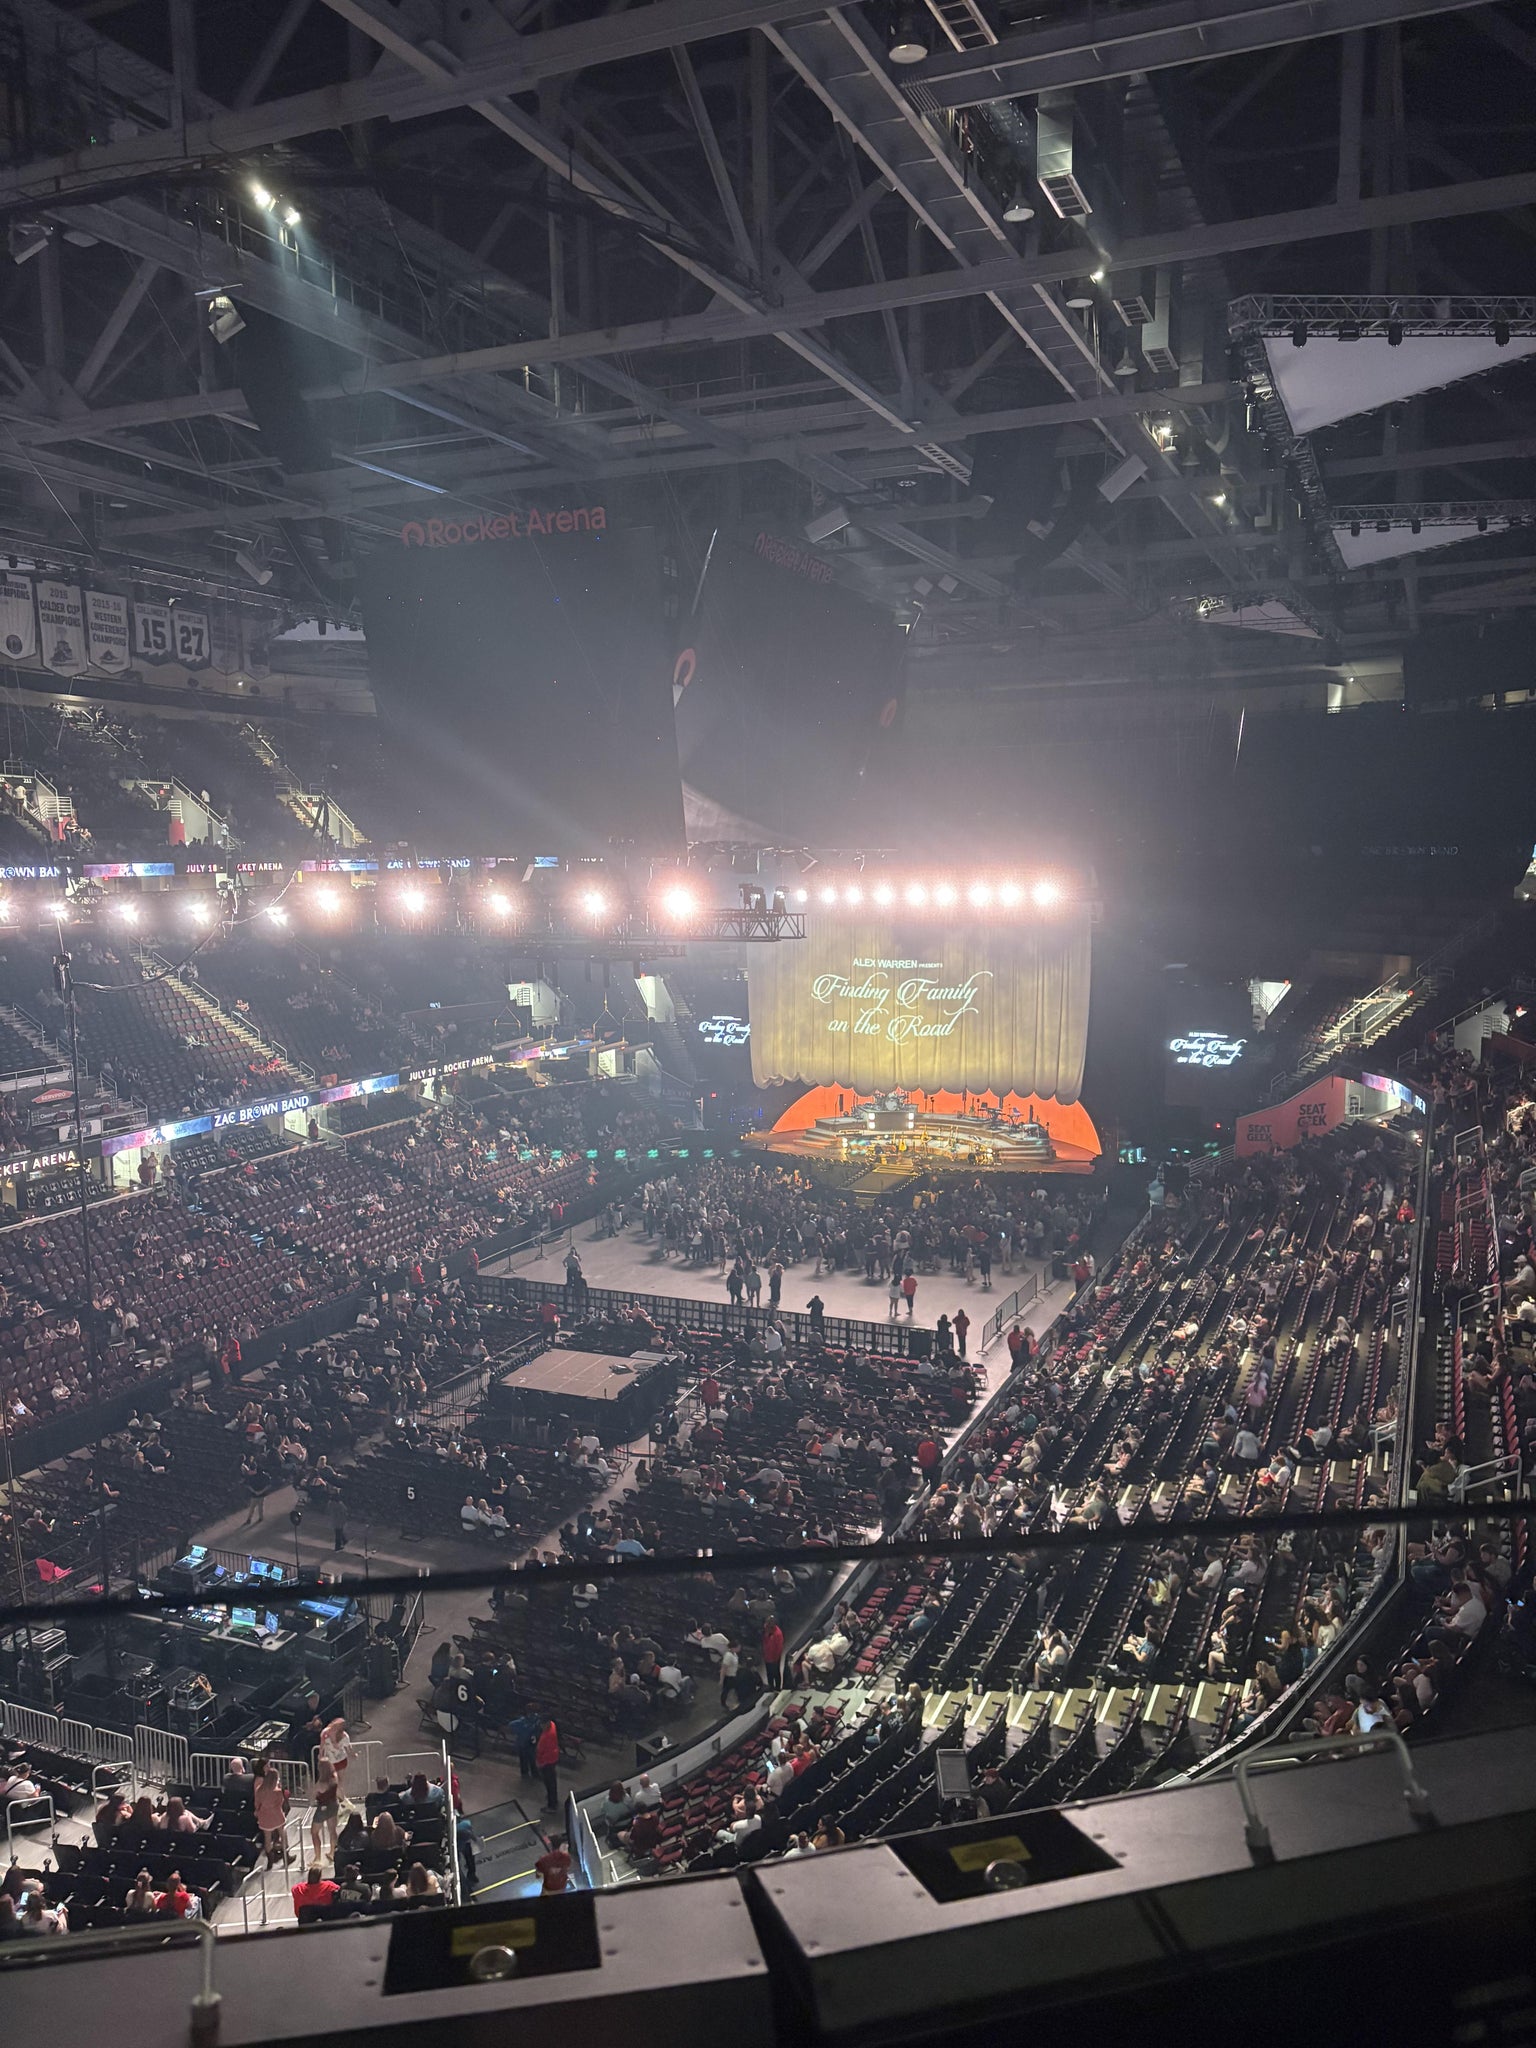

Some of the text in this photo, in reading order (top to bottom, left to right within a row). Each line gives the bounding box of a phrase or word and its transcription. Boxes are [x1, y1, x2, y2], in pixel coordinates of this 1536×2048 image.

[427, 506, 607, 546] Rocket Arena
[40, 600, 80, 615] CALDER CUP
[41, 613, 80, 627] CHAMPIONS
[94, 612, 122, 624] WESTERN
[90, 623, 128, 636] CONFERENCE
[142, 618, 166, 650] 15
[92, 633, 127, 647] CHAMPIONS
[179, 625, 205, 657] 27
[186, 864, 206, 873] JULY
[258, 862, 284, 871] ARENA
[853, 957, 876, 967] ALEX
[877, 959, 918, 969] WARREN
[811, 970, 994, 1010] Finding Family
[828, 1007, 979, 1046] on the Road
[409, 1069, 426, 1082] JULY
[443, 1060, 470, 1074] ROCKET
[471, 1054, 494, 1067] ARENA
[214, 1095, 309, 1128] ZAC BROWN BAND
[1299, 1102, 1327, 1116] SEAT
[1247, 1124, 1273, 1134] SEAT
[1247, 1133, 1272, 1142] GEEK
[32, 1150, 76, 1170] ARENA
[690, 1353, 696, 1365] 2
[654, 1422, 663, 1435] 3
[407, 1486, 416, 1500] 5
[457, 1684, 469, 1702] 6
